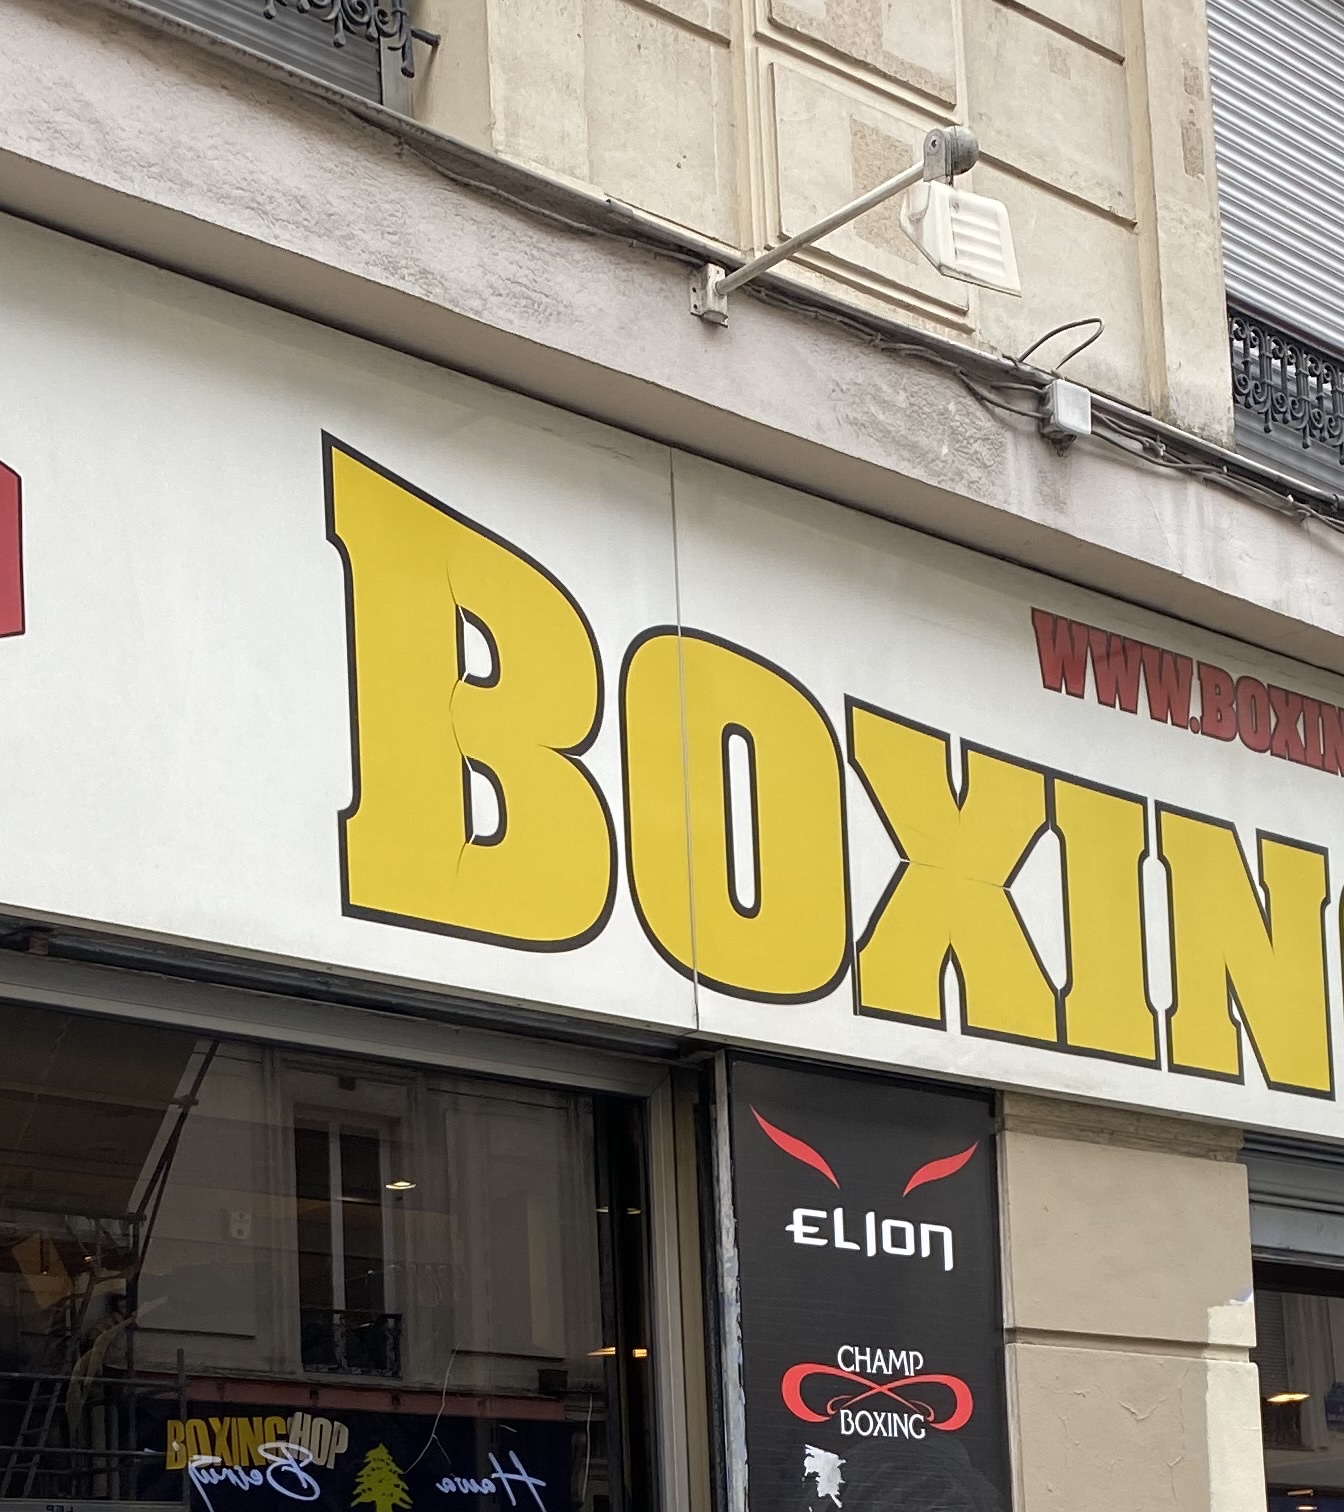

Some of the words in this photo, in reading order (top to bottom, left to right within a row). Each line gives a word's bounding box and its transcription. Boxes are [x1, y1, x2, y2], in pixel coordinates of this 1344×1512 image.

[785, 1206, 954, 1272] ELION
[837, 1346, 924, 1377] CHAMP
[165, 1411, 350, 1471] BOXINGHOP
[840, 1409, 926, 1440] BOXING
